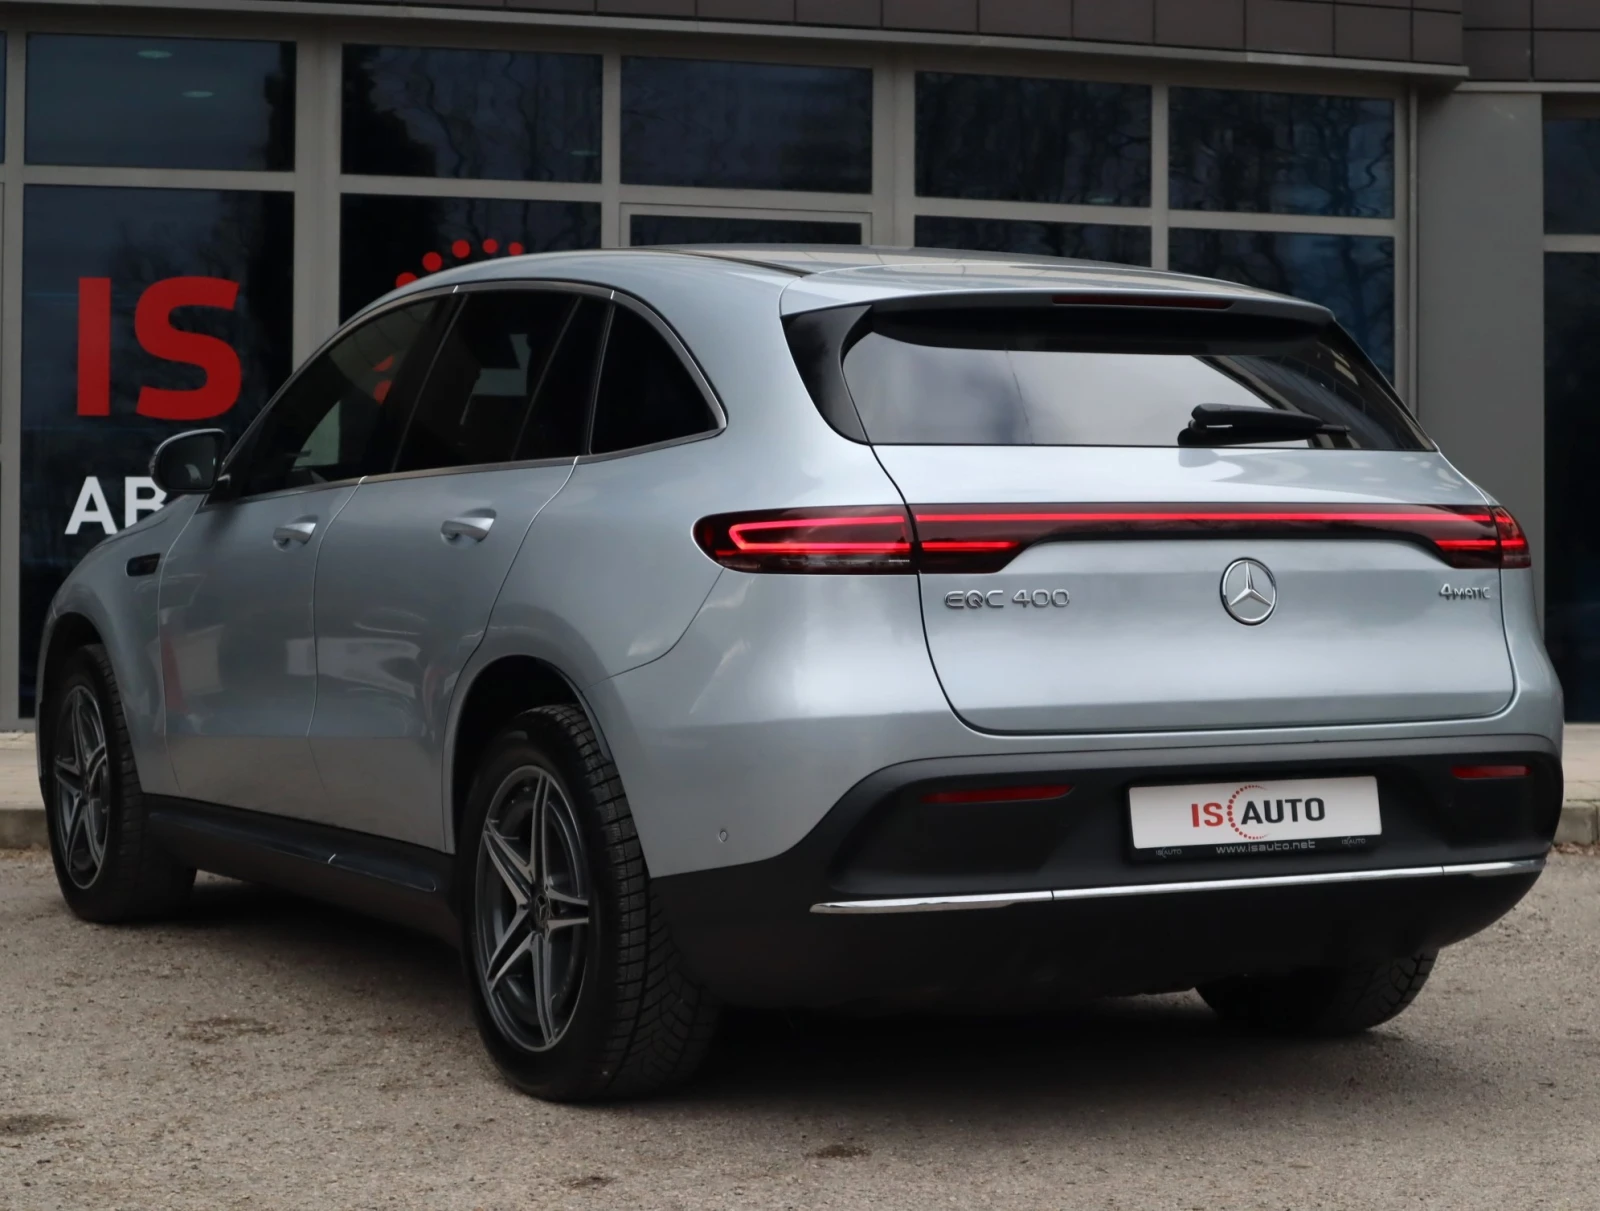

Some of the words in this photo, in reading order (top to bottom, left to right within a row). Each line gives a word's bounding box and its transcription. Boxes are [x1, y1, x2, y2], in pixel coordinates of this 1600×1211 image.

[77, 276, 242, 420] IS
[945, 590, 1004, 608] EQC
[1012, 589, 1069, 607] 400
[1439, 583, 1491, 600] 4MATIC
[1191, 803, 1224, 827] IS
[1240, 797, 1325, 825] AUTO
[1216, 840, 1316, 854] www.isauto.net
